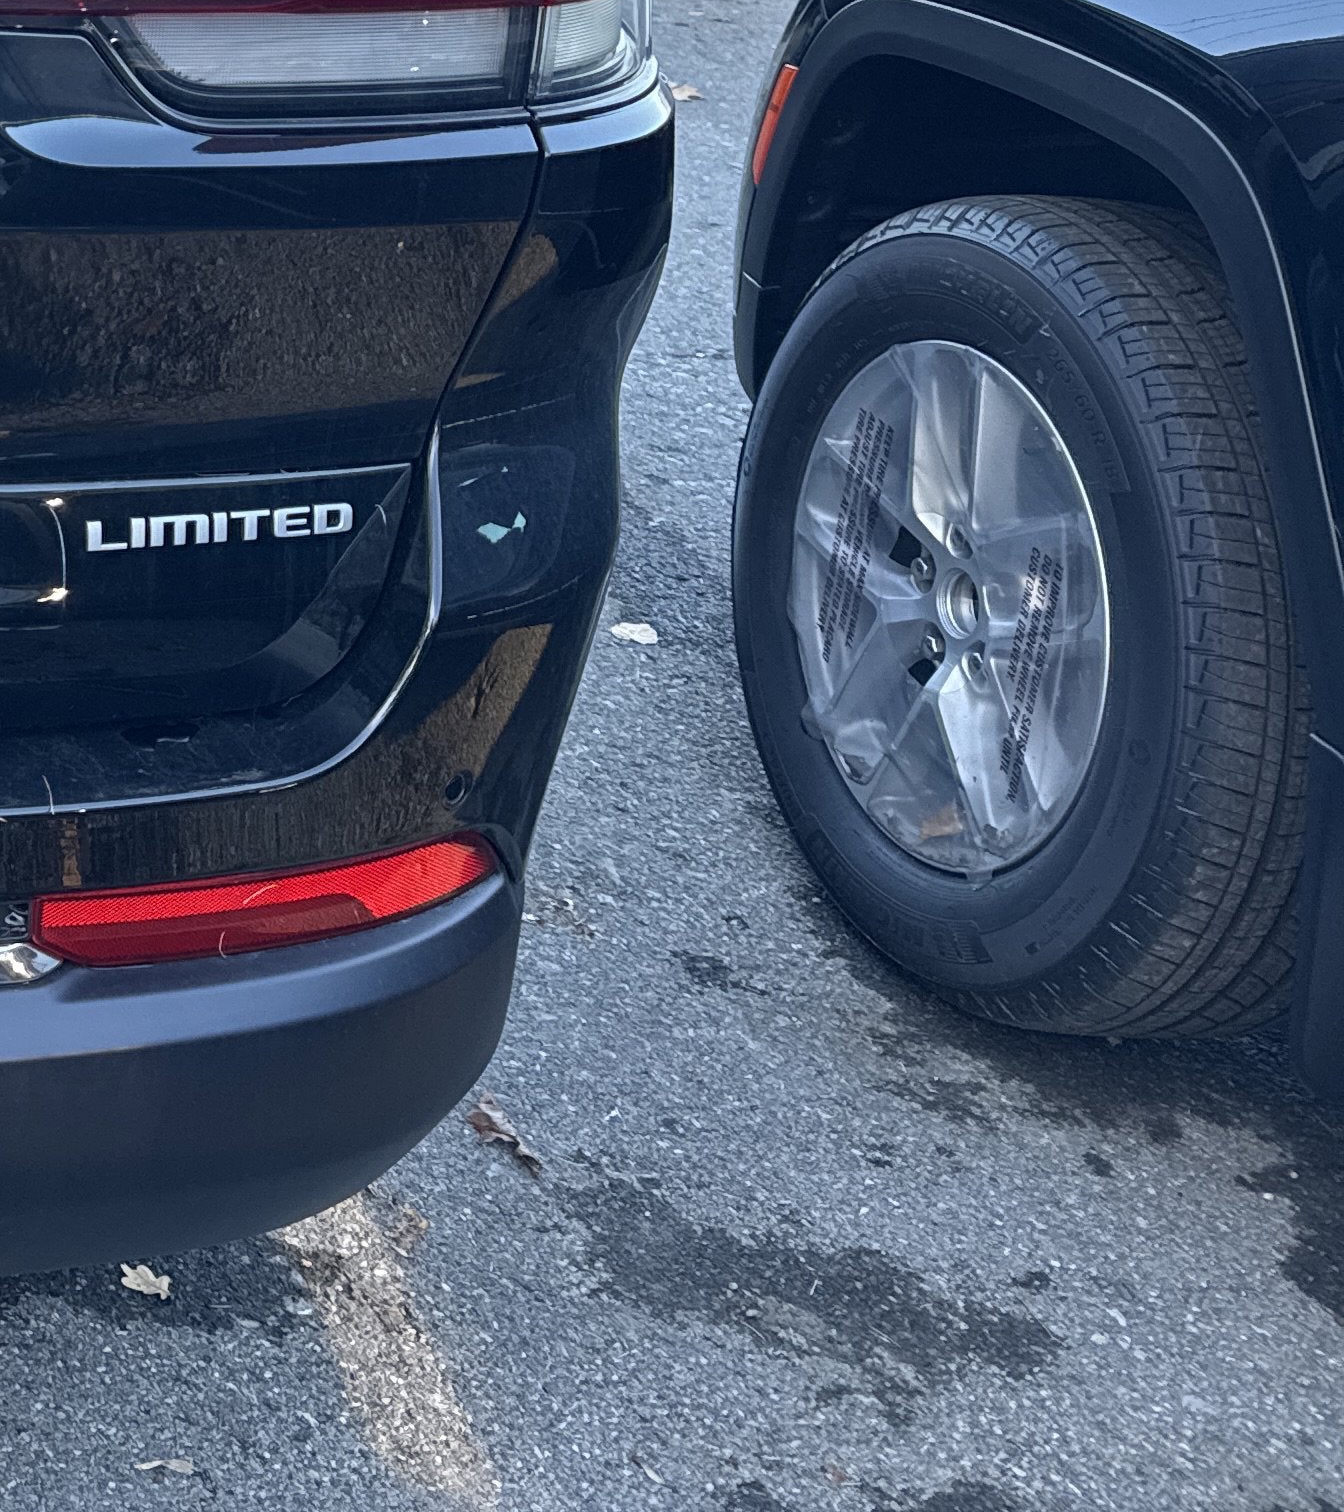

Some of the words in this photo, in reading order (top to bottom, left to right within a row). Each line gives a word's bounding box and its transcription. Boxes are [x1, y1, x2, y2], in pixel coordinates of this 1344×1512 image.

[855, 407, 866, 436] TIRE
[861, 410, 876, 460] ADJUST
[882, 425, 894, 458] KEEP
[876, 457, 887, 486] TIRE
[839, 494, 849, 514] AT
[85, 502, 354, 552] LIMITED
[840, 550, 848, 567] TO
[1040, 553, 1053, 576] DO
[1053, 562, 1064, 582] TO
[1019, 546, 1041, 619] CUSTOMER
[1034, 575, 1048, 605] NOT
[1040, 580, 1060, 643] IMPROVE
[1023, 605, 1042, 661] REMOVE
[1014, 659, 1030, 704] WHEEL
[1024, 642, 1047, 714] CUSTOMER
[999, 736, 1013, 775] UNTIL
